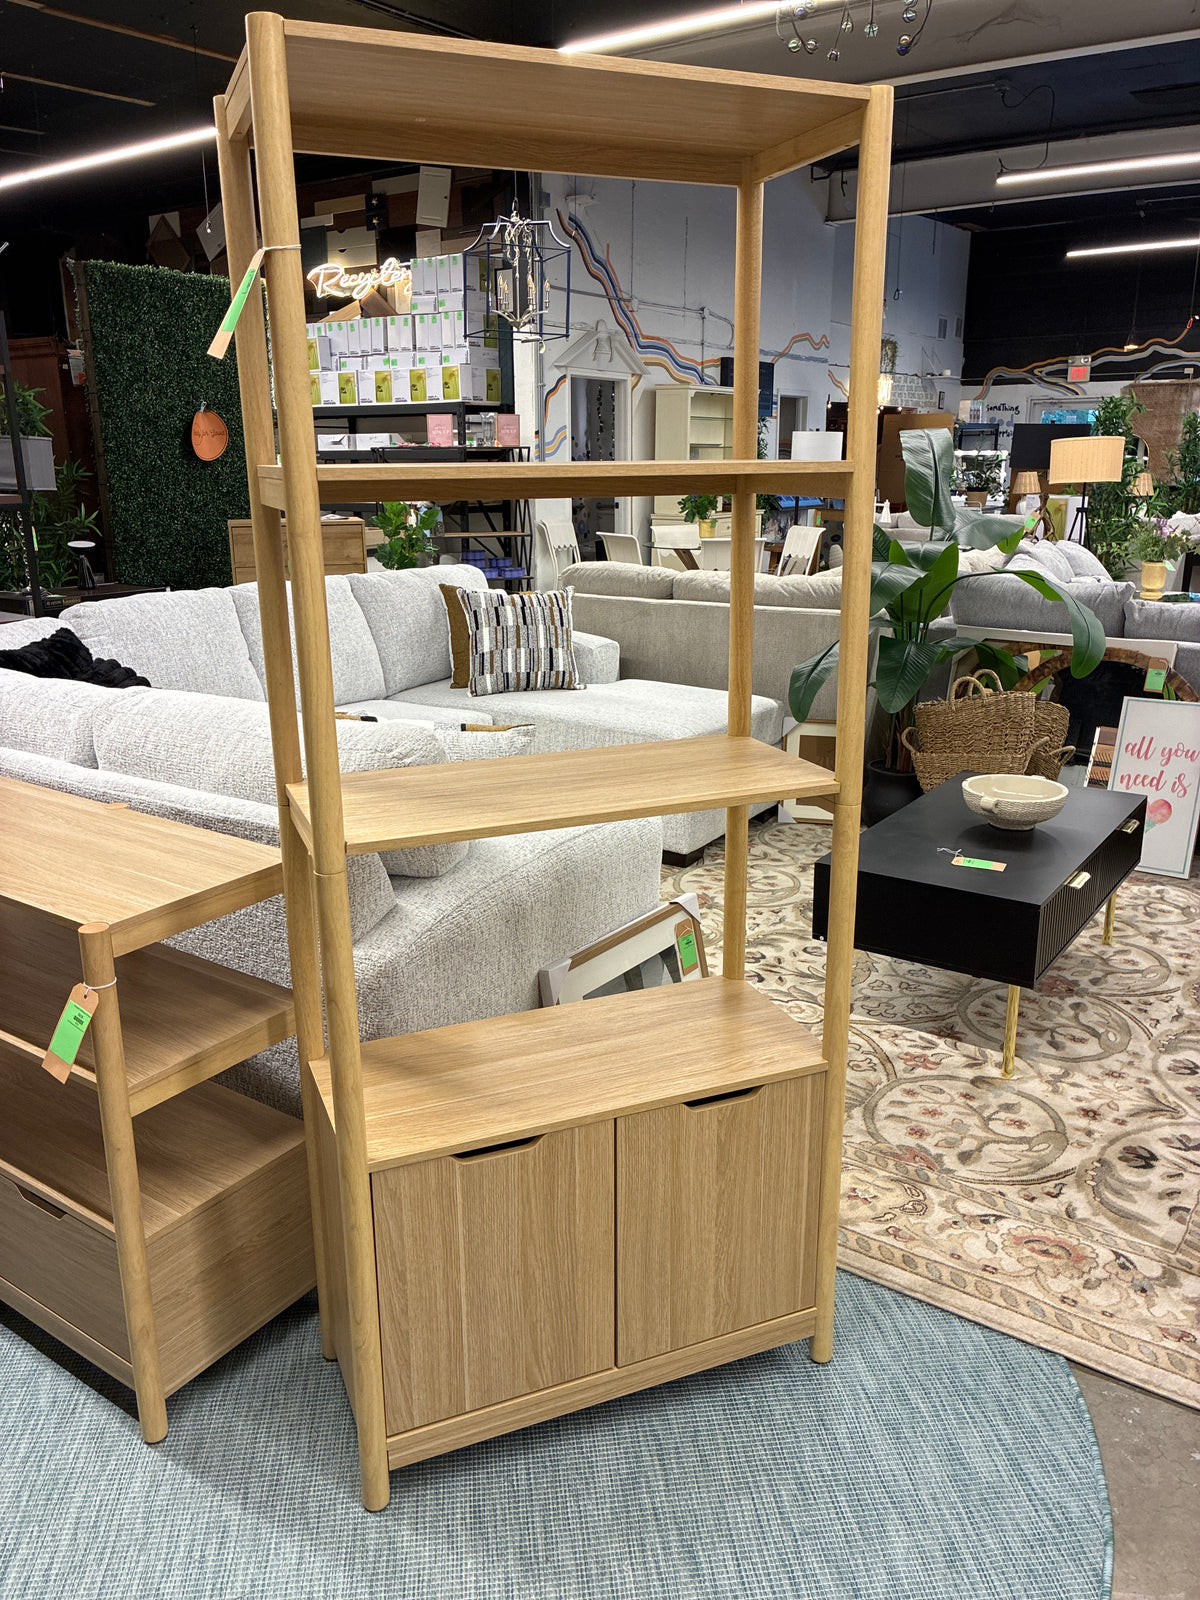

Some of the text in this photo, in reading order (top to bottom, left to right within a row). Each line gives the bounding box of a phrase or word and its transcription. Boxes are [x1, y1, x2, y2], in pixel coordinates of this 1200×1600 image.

[1124, 735, 1200, 767] all you
[1119, 769, 1192, 799] need is
